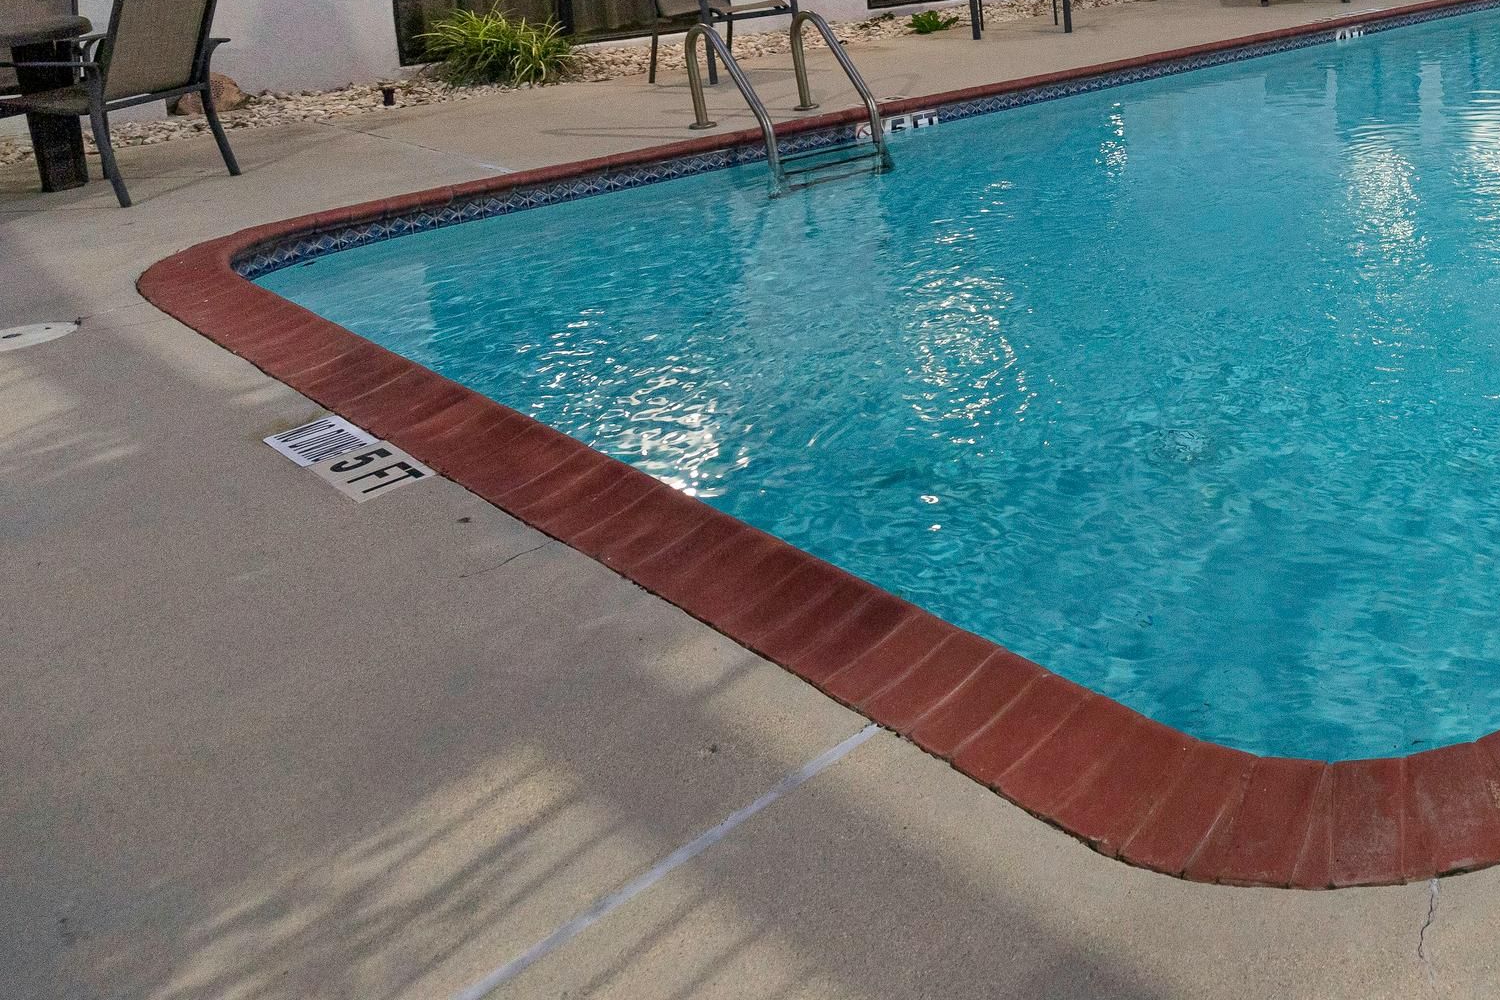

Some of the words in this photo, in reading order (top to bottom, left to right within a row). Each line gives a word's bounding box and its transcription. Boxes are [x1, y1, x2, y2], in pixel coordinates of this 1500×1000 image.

[912, 112, 937, 129] FT
[273, 420, 336, 443] NO
[288, 428, 368, 462] DIVING
[330, 448, 392, 472] 5
[347, 461, 426, 494] FT
